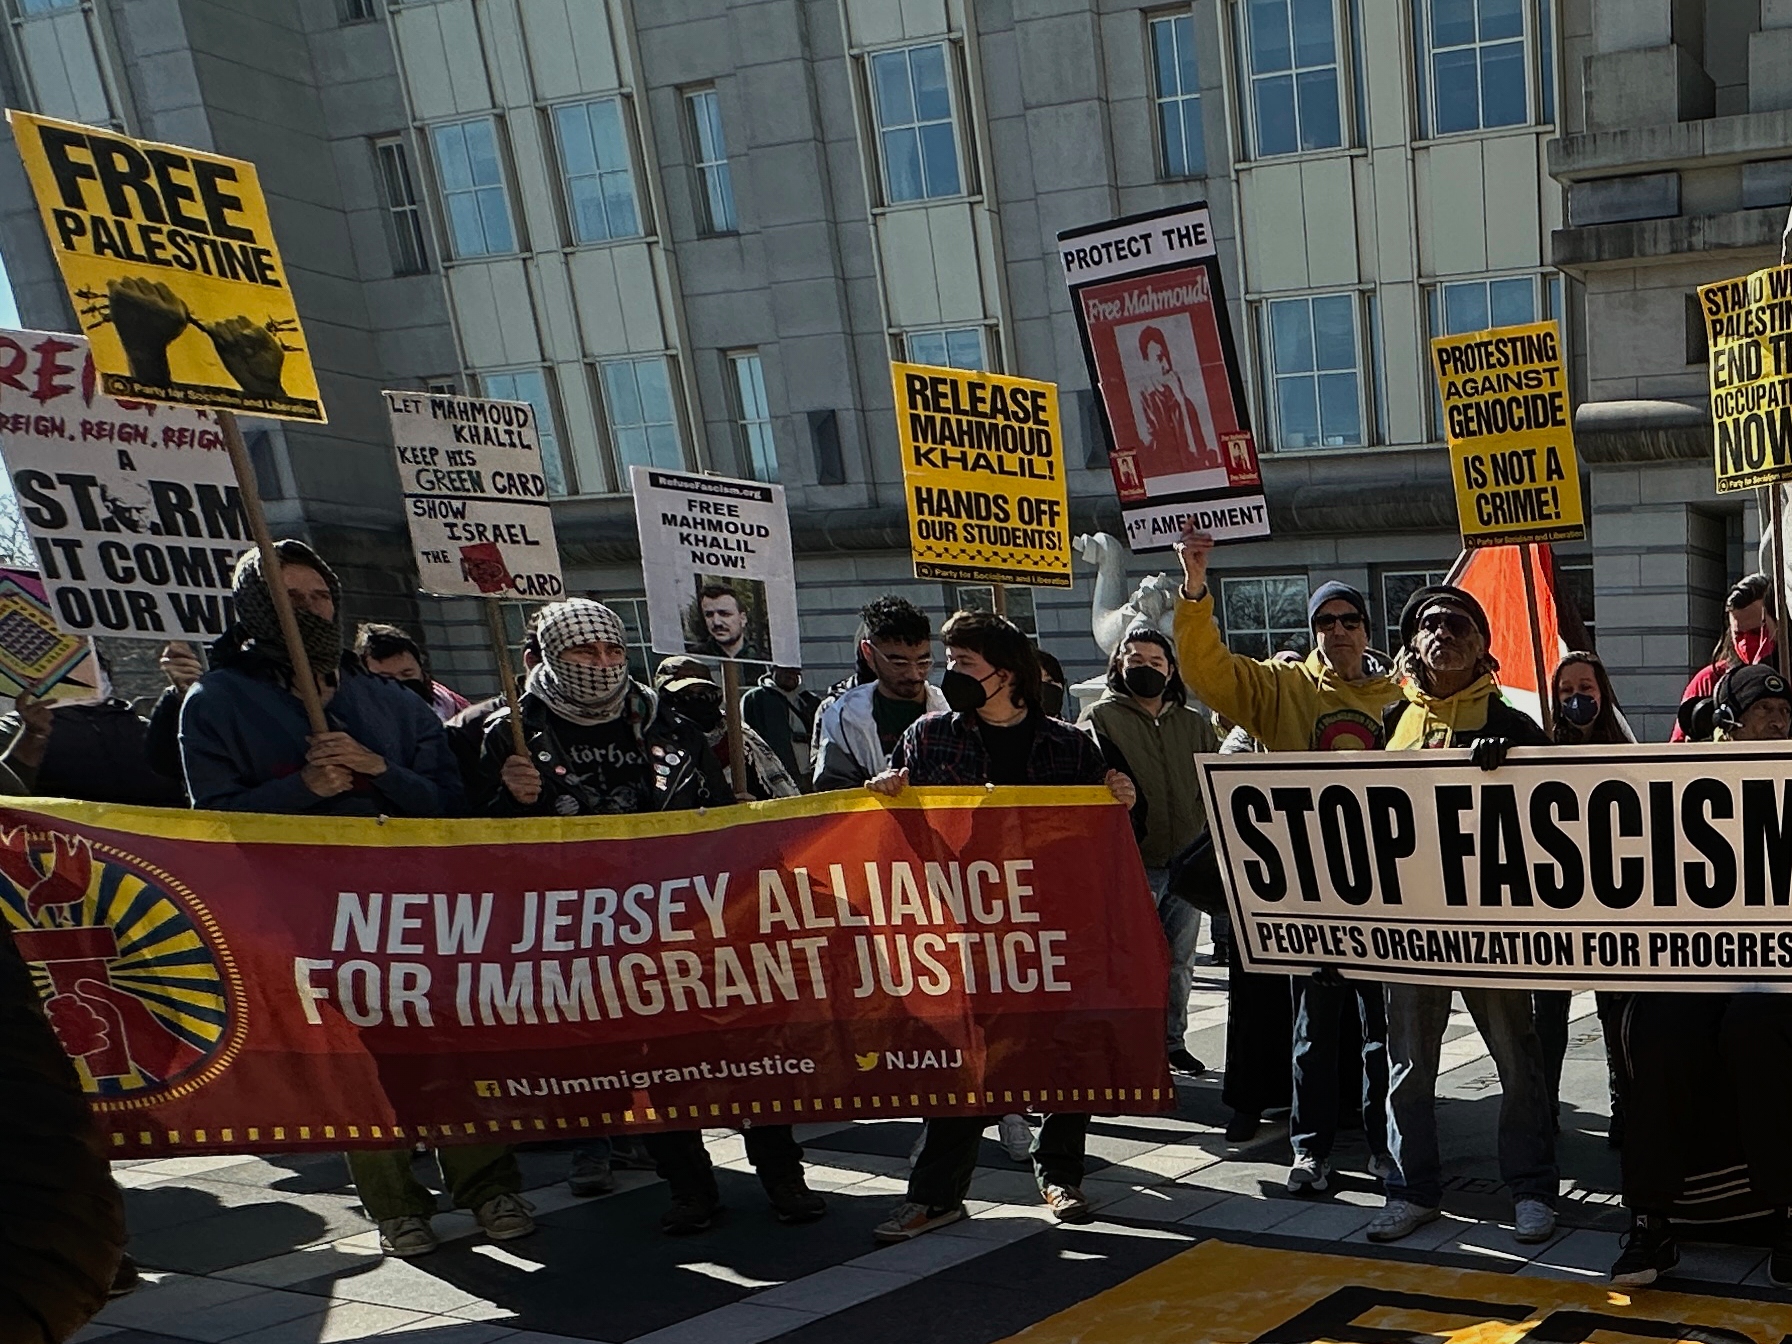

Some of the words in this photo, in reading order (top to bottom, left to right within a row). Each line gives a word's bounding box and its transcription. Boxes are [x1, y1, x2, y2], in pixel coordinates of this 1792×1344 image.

[38, 125, 256, 244] FREE
[52, 208, 282, 288] PALESTINE
[1063, 232, 1153, 272] PROTECT
[1162, 222, 1208, 251] THE
[1088, 298, 1122, 325] Free
[1123, 274, 1208, 317] Mahmoud!
[1704, 276, 1763, 318] STAND
[1437, 331, 1558, 377] PROTESTING
[1713, 338, 1763, 390] END
[905, 373, 1050, 428] RELEASE
[1445, 366, 1560, 401] AGAINST
[389, 394, 422, 414] LET
[430, 398, 529, 429] MAHMOUD
[1448, 391, 1567, 440] GENOCIDE
[453, 424, 532, 450] KHALIL
[909, 412, 1053, 458] MAHMOUD
[117, 449, 137, 471] A
[397, 446, 440, 466] KEEP
[445, 449, 477, 467] HIS
[913, 445, 1055, 481] KHALIL!
[1463, 454, 1488, 490] IS
[1490, 448, 1537, 487] NOT
[1546, 446, 1565, 482] A
[415, 468, 486, 494] GREEN
[492, 471, 545, 497] CARD
[658, 476, 762, 500] RefuseFascism.org
[413, 500, 467, 520] SHOW
[661, 512, 770, 538] MAHMOUD
[687, 499, 740, 518] FREE
[914, 486, 1011, 524] HANDS
[1017, 496, 1061, 528] OFF
[1475, 486, 1562, 527] CRIME!
[443, 522, 540, 546] ISRAEL
[679, 532, 756, 554] KHALIL
[917, 519, 958, 543] OUR
[963, 522, 1063, 551] STUDENTS!
[34, 536, 87, 581] IT
[421, 550, 453, 564] THE
[691, 551, 746, 569] NOW!
[513, 574, 562, 597] CARD
[56, 587, 165, 633] OUR
[1230, 784, 1417, 906] STOP
[331, 892, 494, 955] NEW
[511, 871, 731, 954] JERSEY
[758, 859, 1041, 934] ALLIANCE
[1255, 921, 1368, 958] PEOPLE'S
[1370, 926, 1574, 966] ORGANIZATION
[1581, 932, 1640, 967] FOR
[293, 956, 435, 1028] FOR
[455, 936, 829, 1027] IMMIGRANT
[853, 930, 1072, 998] JUSTICE
[507, 1054, 816, 1098] NJImmigrantJustice
[885, 1048, 964, 1071] NJAIJ
